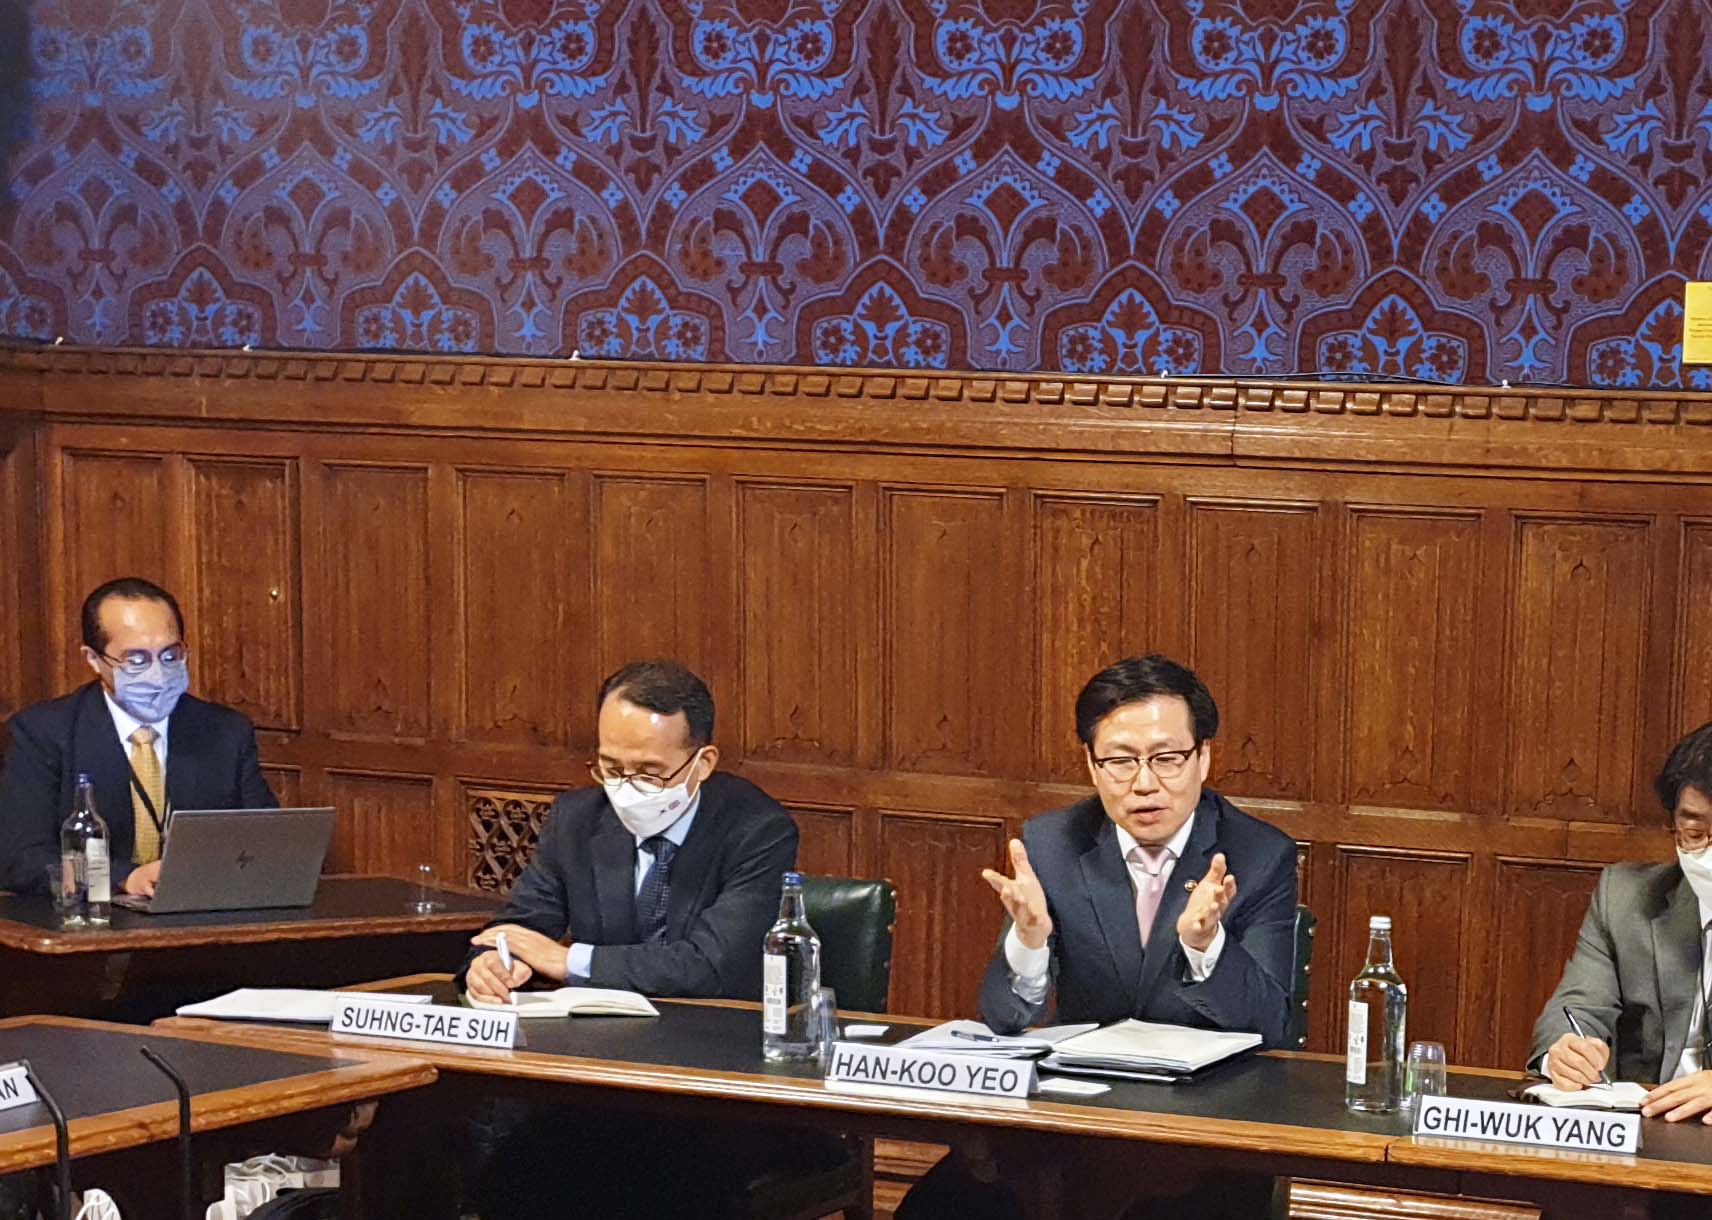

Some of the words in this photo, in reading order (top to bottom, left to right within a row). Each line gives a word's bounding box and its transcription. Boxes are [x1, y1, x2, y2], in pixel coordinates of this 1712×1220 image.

[341, 1006, 461, 1038] SUHNG-TAE
[466, 1018, 510, 1043] SUH
[835, 1052, 957, 1087] HAN-KOO
[966, 1064, 1019, 1093] YEO
[1423, 1105, 1544, 1141] GHI-WUK
[1552, 1116, 1627, 1148] YANG
